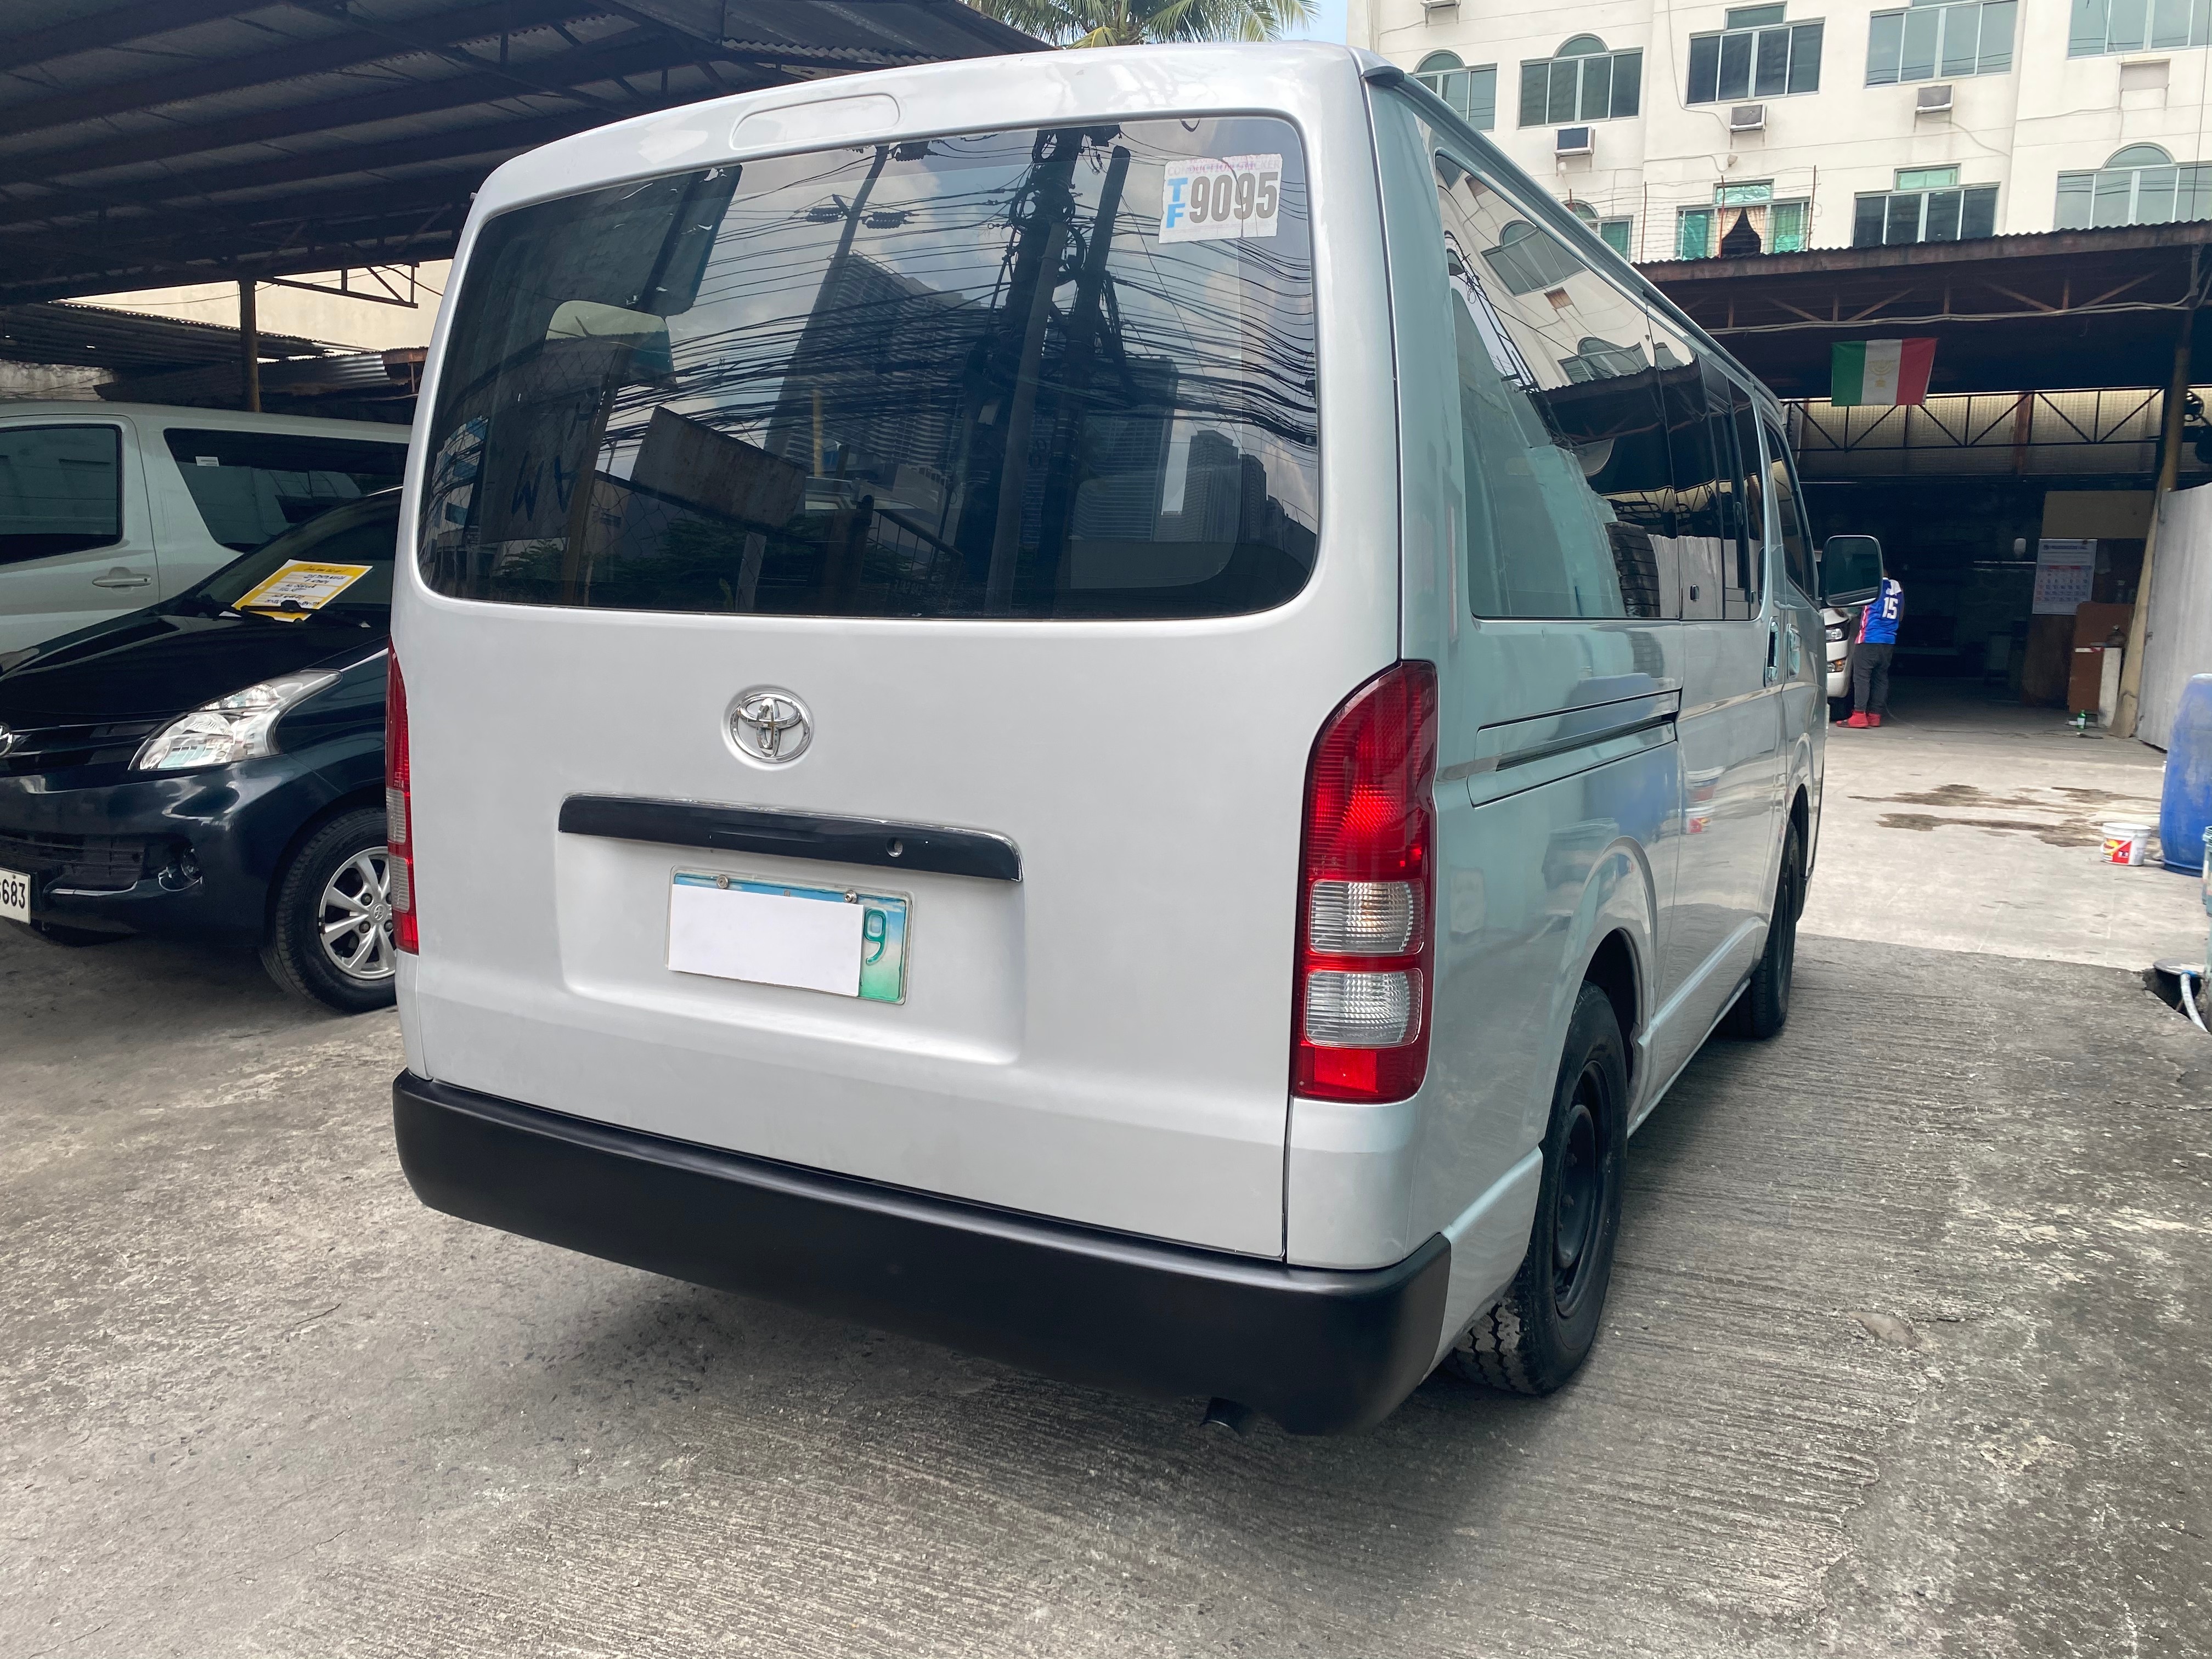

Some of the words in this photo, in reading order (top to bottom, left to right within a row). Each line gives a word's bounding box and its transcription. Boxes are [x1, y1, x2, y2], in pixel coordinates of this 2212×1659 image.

[1189, 172, 1279, 223] 9095
[1882, 597, 1898, 619] 15
[0, 878, 25, 909] 683
